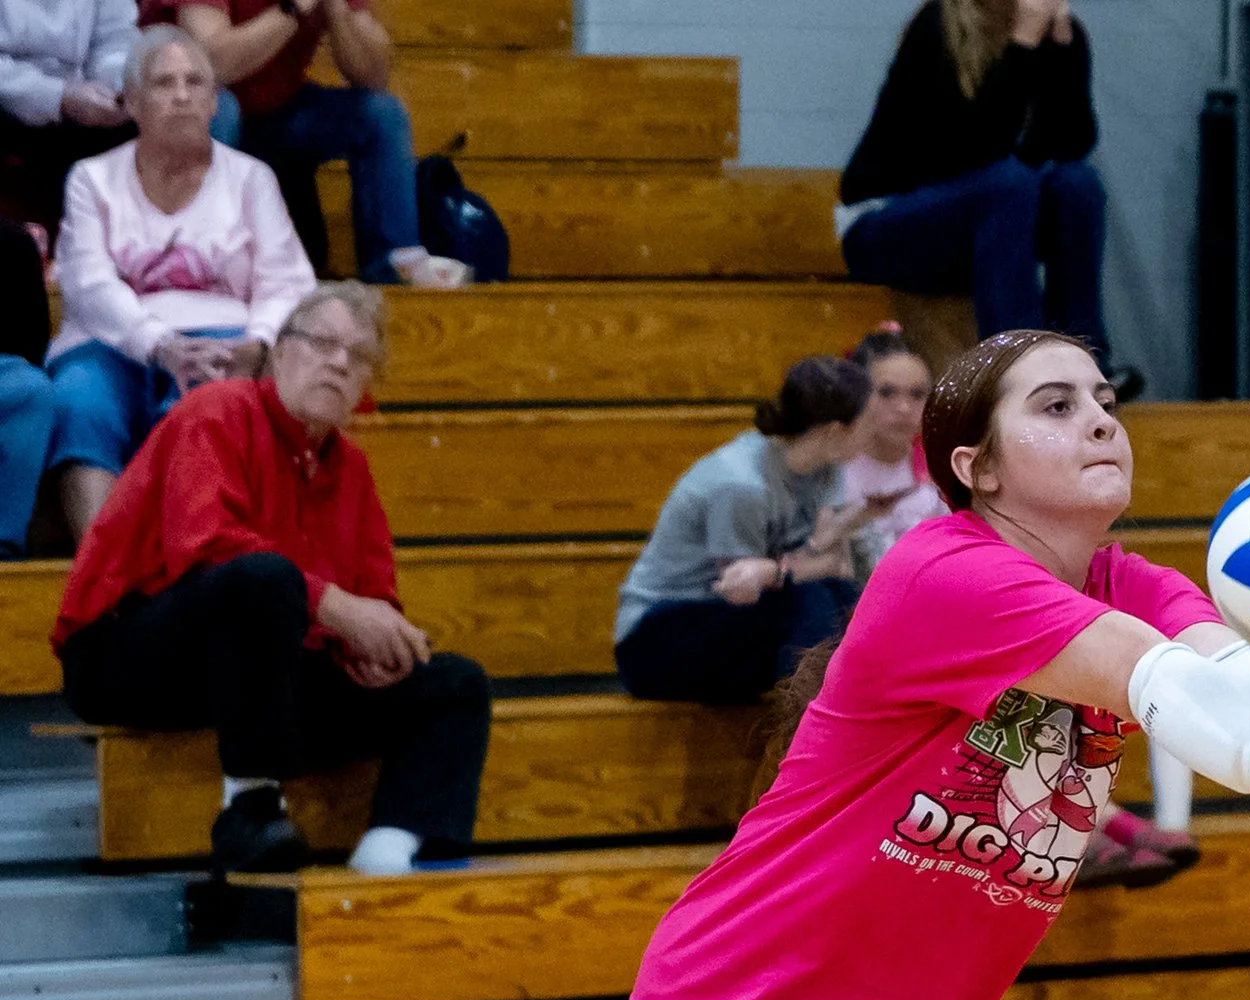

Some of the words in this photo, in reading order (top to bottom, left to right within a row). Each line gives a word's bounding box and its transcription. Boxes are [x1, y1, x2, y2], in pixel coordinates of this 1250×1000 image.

[965, 688, 1047, 769] K
[979, 688, 1018, 742] CAPTAINS
[895, 790, 1010, 865] DIG
[879, 839, 920, 866] RIVALS
[919, 858, 937, 870] ON
[936, 860, 956, 872] THE
[955, 864, 991, 882] COURT
[1024, 896, 1062, 913] UNITED
